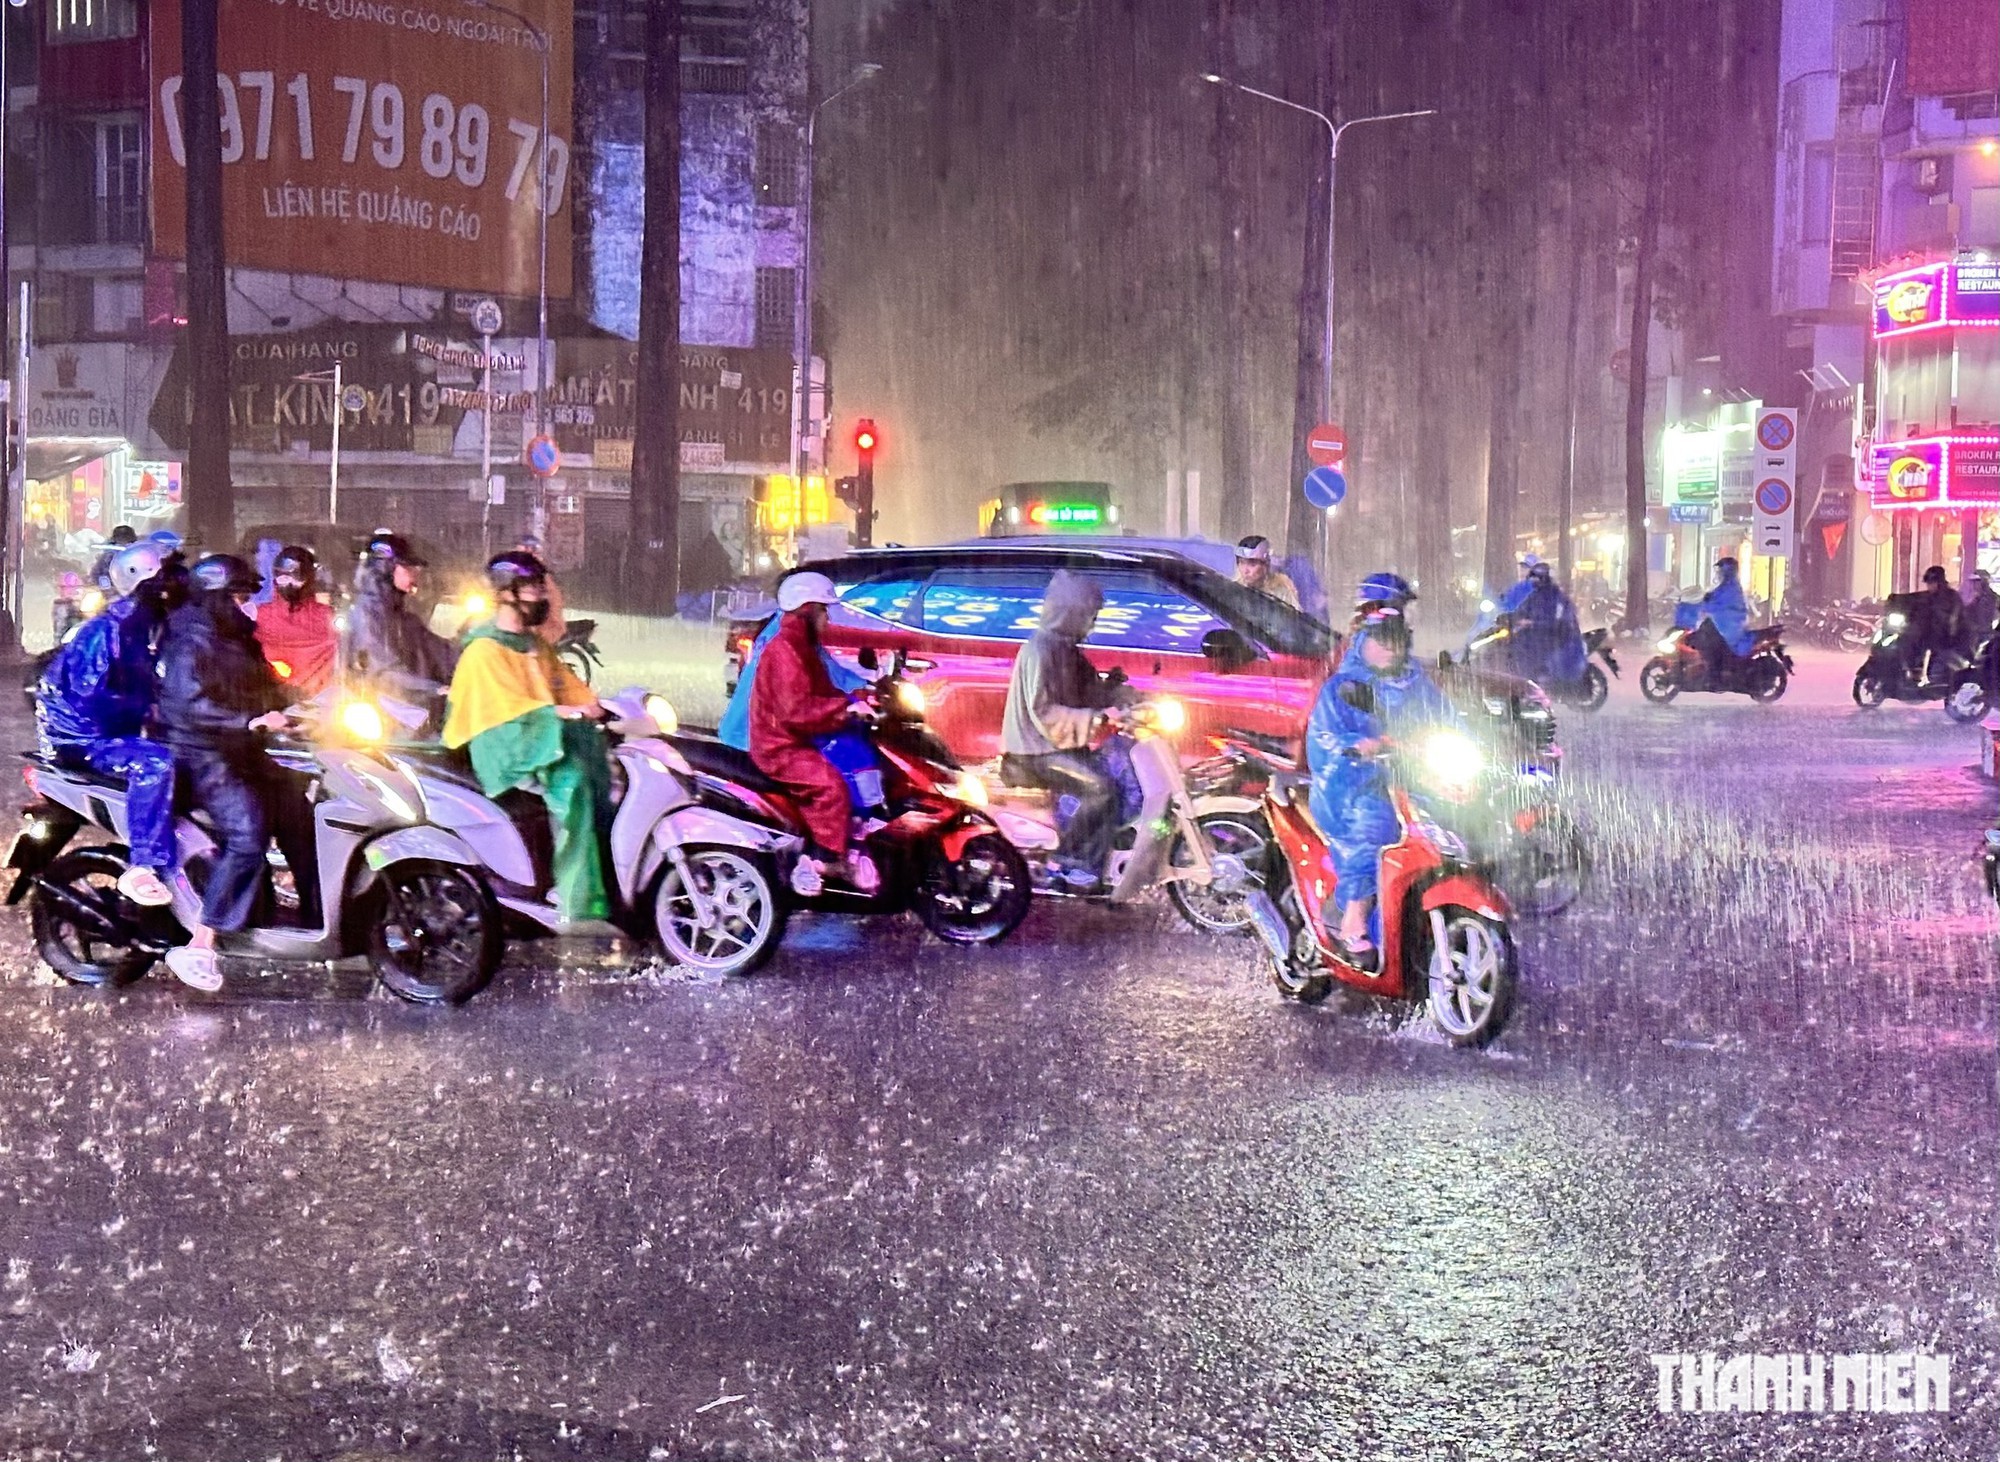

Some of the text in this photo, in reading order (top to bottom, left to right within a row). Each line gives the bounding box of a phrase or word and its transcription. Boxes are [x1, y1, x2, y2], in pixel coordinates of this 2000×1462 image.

[334, 76, 405, 169] 79
[420, 93, 490, 188] 89
[504, 117, 570, 217] 79
[262, 180, 482, 243] LIÊN HỆ QUẢNG CÁO
[738, 387, 788, 415] 419
